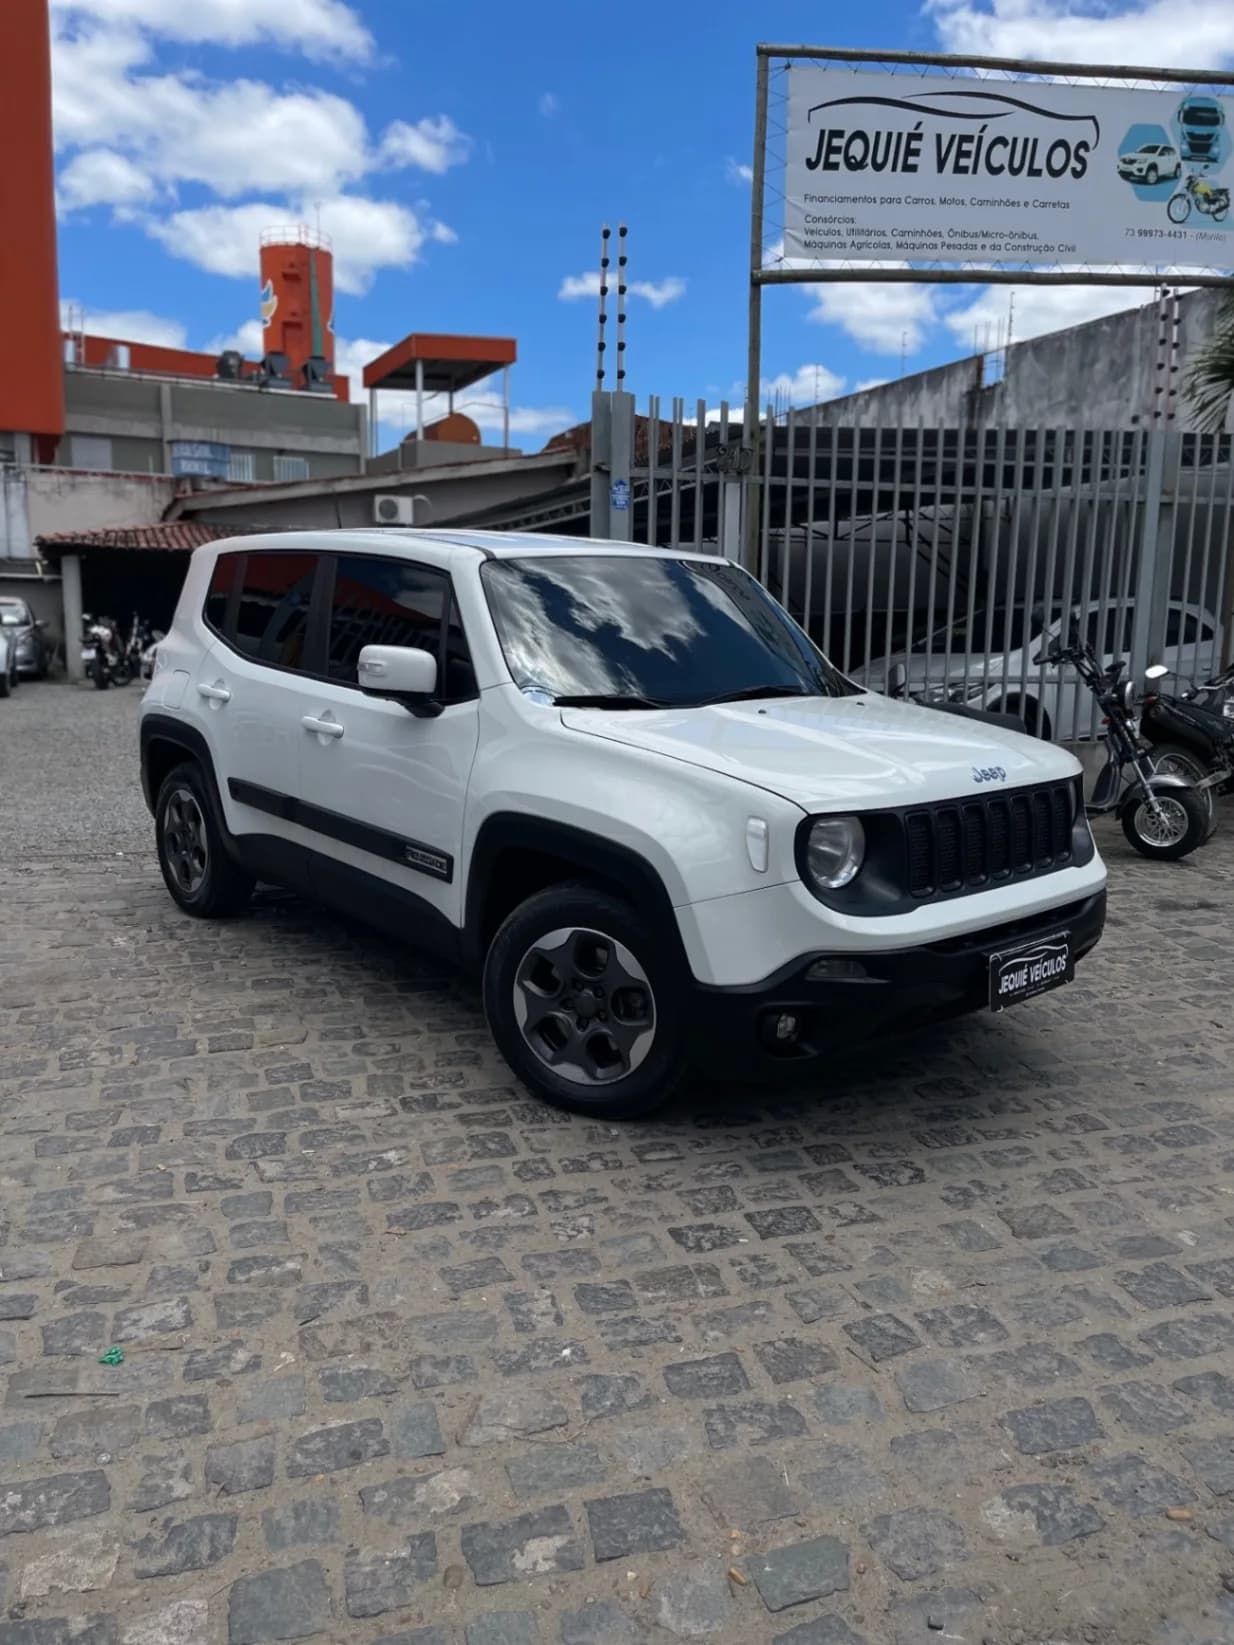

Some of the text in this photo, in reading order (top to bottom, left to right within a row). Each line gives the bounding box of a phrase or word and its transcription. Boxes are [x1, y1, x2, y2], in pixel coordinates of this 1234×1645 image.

[805, 121, 1091, 180] JEQUIÉ VEÍCULOS
[803, 193, 878, 204] Financiamentos
[880, 195, 902, 205] para
[939, 196, 968, 207] Motos,
[969, 196, 1021, 208] Caminhões
[1023, 200, 1030, 209] e
[1032, 199, 1070, 209] Carretas
[891, 227, 945, 239] Caminhões,
[1125, 227, 1136, 238] 73
[803, 239, 847, 251] Máquinas
[895, 240, 938, 252] Máquinas
[940, 241, 978, 251] Pesadas
[980, 243, 987, 251] e
[989, 241, 1002, 252] da
[1004, 242, 1055, 254] Construção
[1057, 243, 1077, 253] Civil
[972, 766, 1006, 783] Jeep
[998, 963, 1028, 994] JEQUIÉ
[1029, 954, 1067, 983] VEÍCULOS
